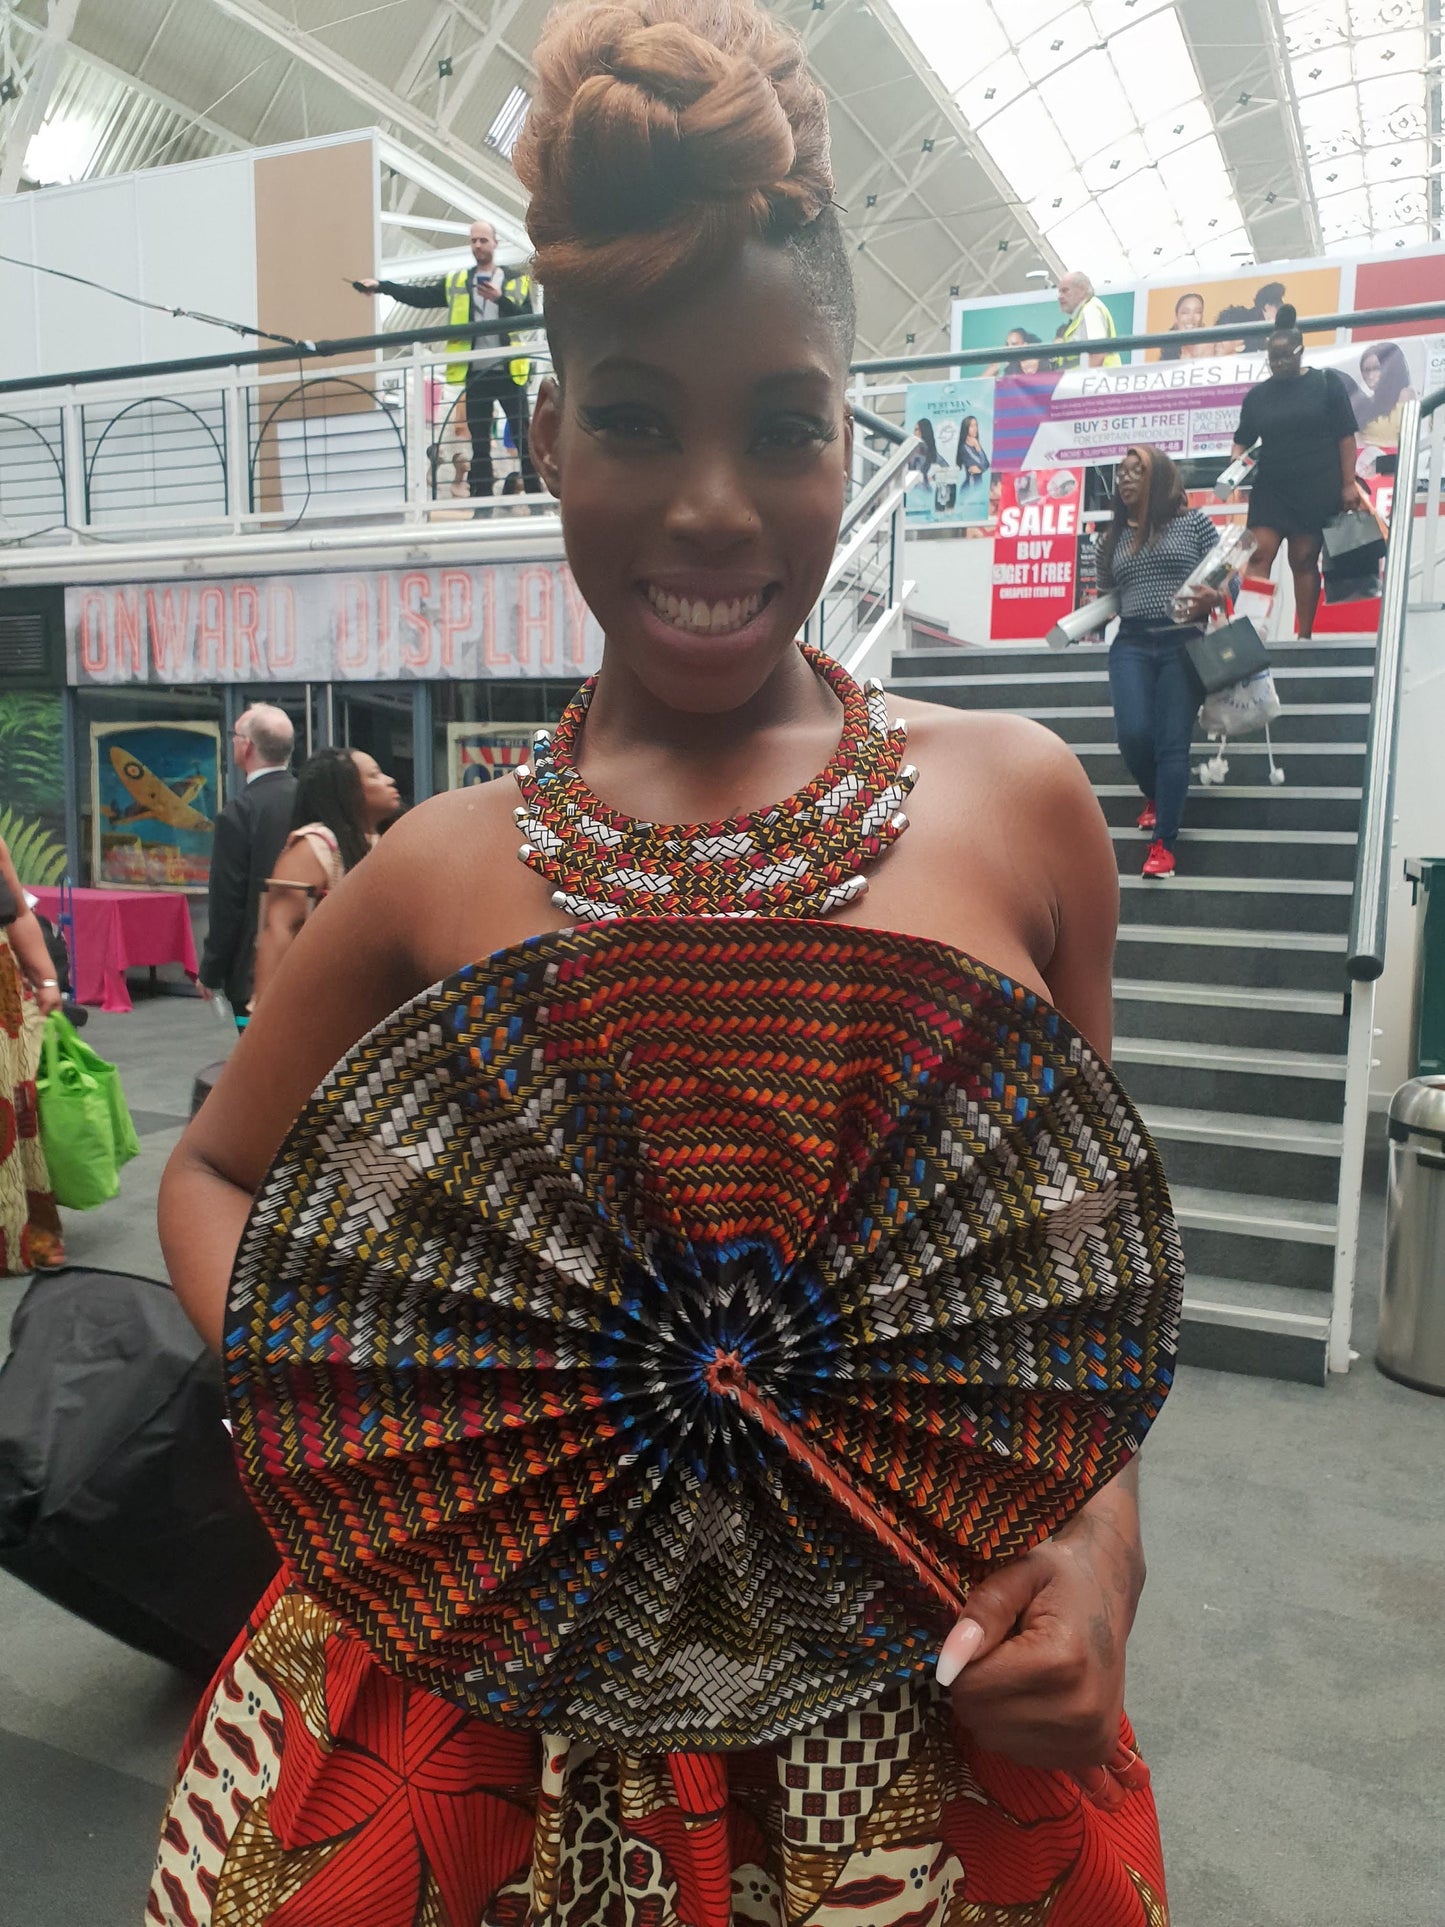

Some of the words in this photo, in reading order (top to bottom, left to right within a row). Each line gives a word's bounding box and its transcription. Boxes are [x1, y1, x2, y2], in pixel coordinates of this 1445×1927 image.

[1081, 365, 1222, 394] FABBABES
[1235, 358, 1272, 382] HA
[1073, 420, 1099, 434] BUY
[1101, 420, 1108, 431] 3
[1111, 417, 1138, 430] GET
[1141, 416, 1147, 428] 1
[1151, 413, 1185, 427] FREE
[1074, 434, 1092, 445] FOR
[1092, 430, 1130, 444] CERTAIN
[1133, 427, 1185, 441] PRODUCTS
[1000, 504, 1076, 538] SALE
[1016, 540, 1053, 560] BUY
[1032, 563, 1039, 583] 1
[1041, 562, 1072, 583] FREE
[81, 584, 296, 672] ONWARD
[336, 565, 588, 668] DISPLAY
